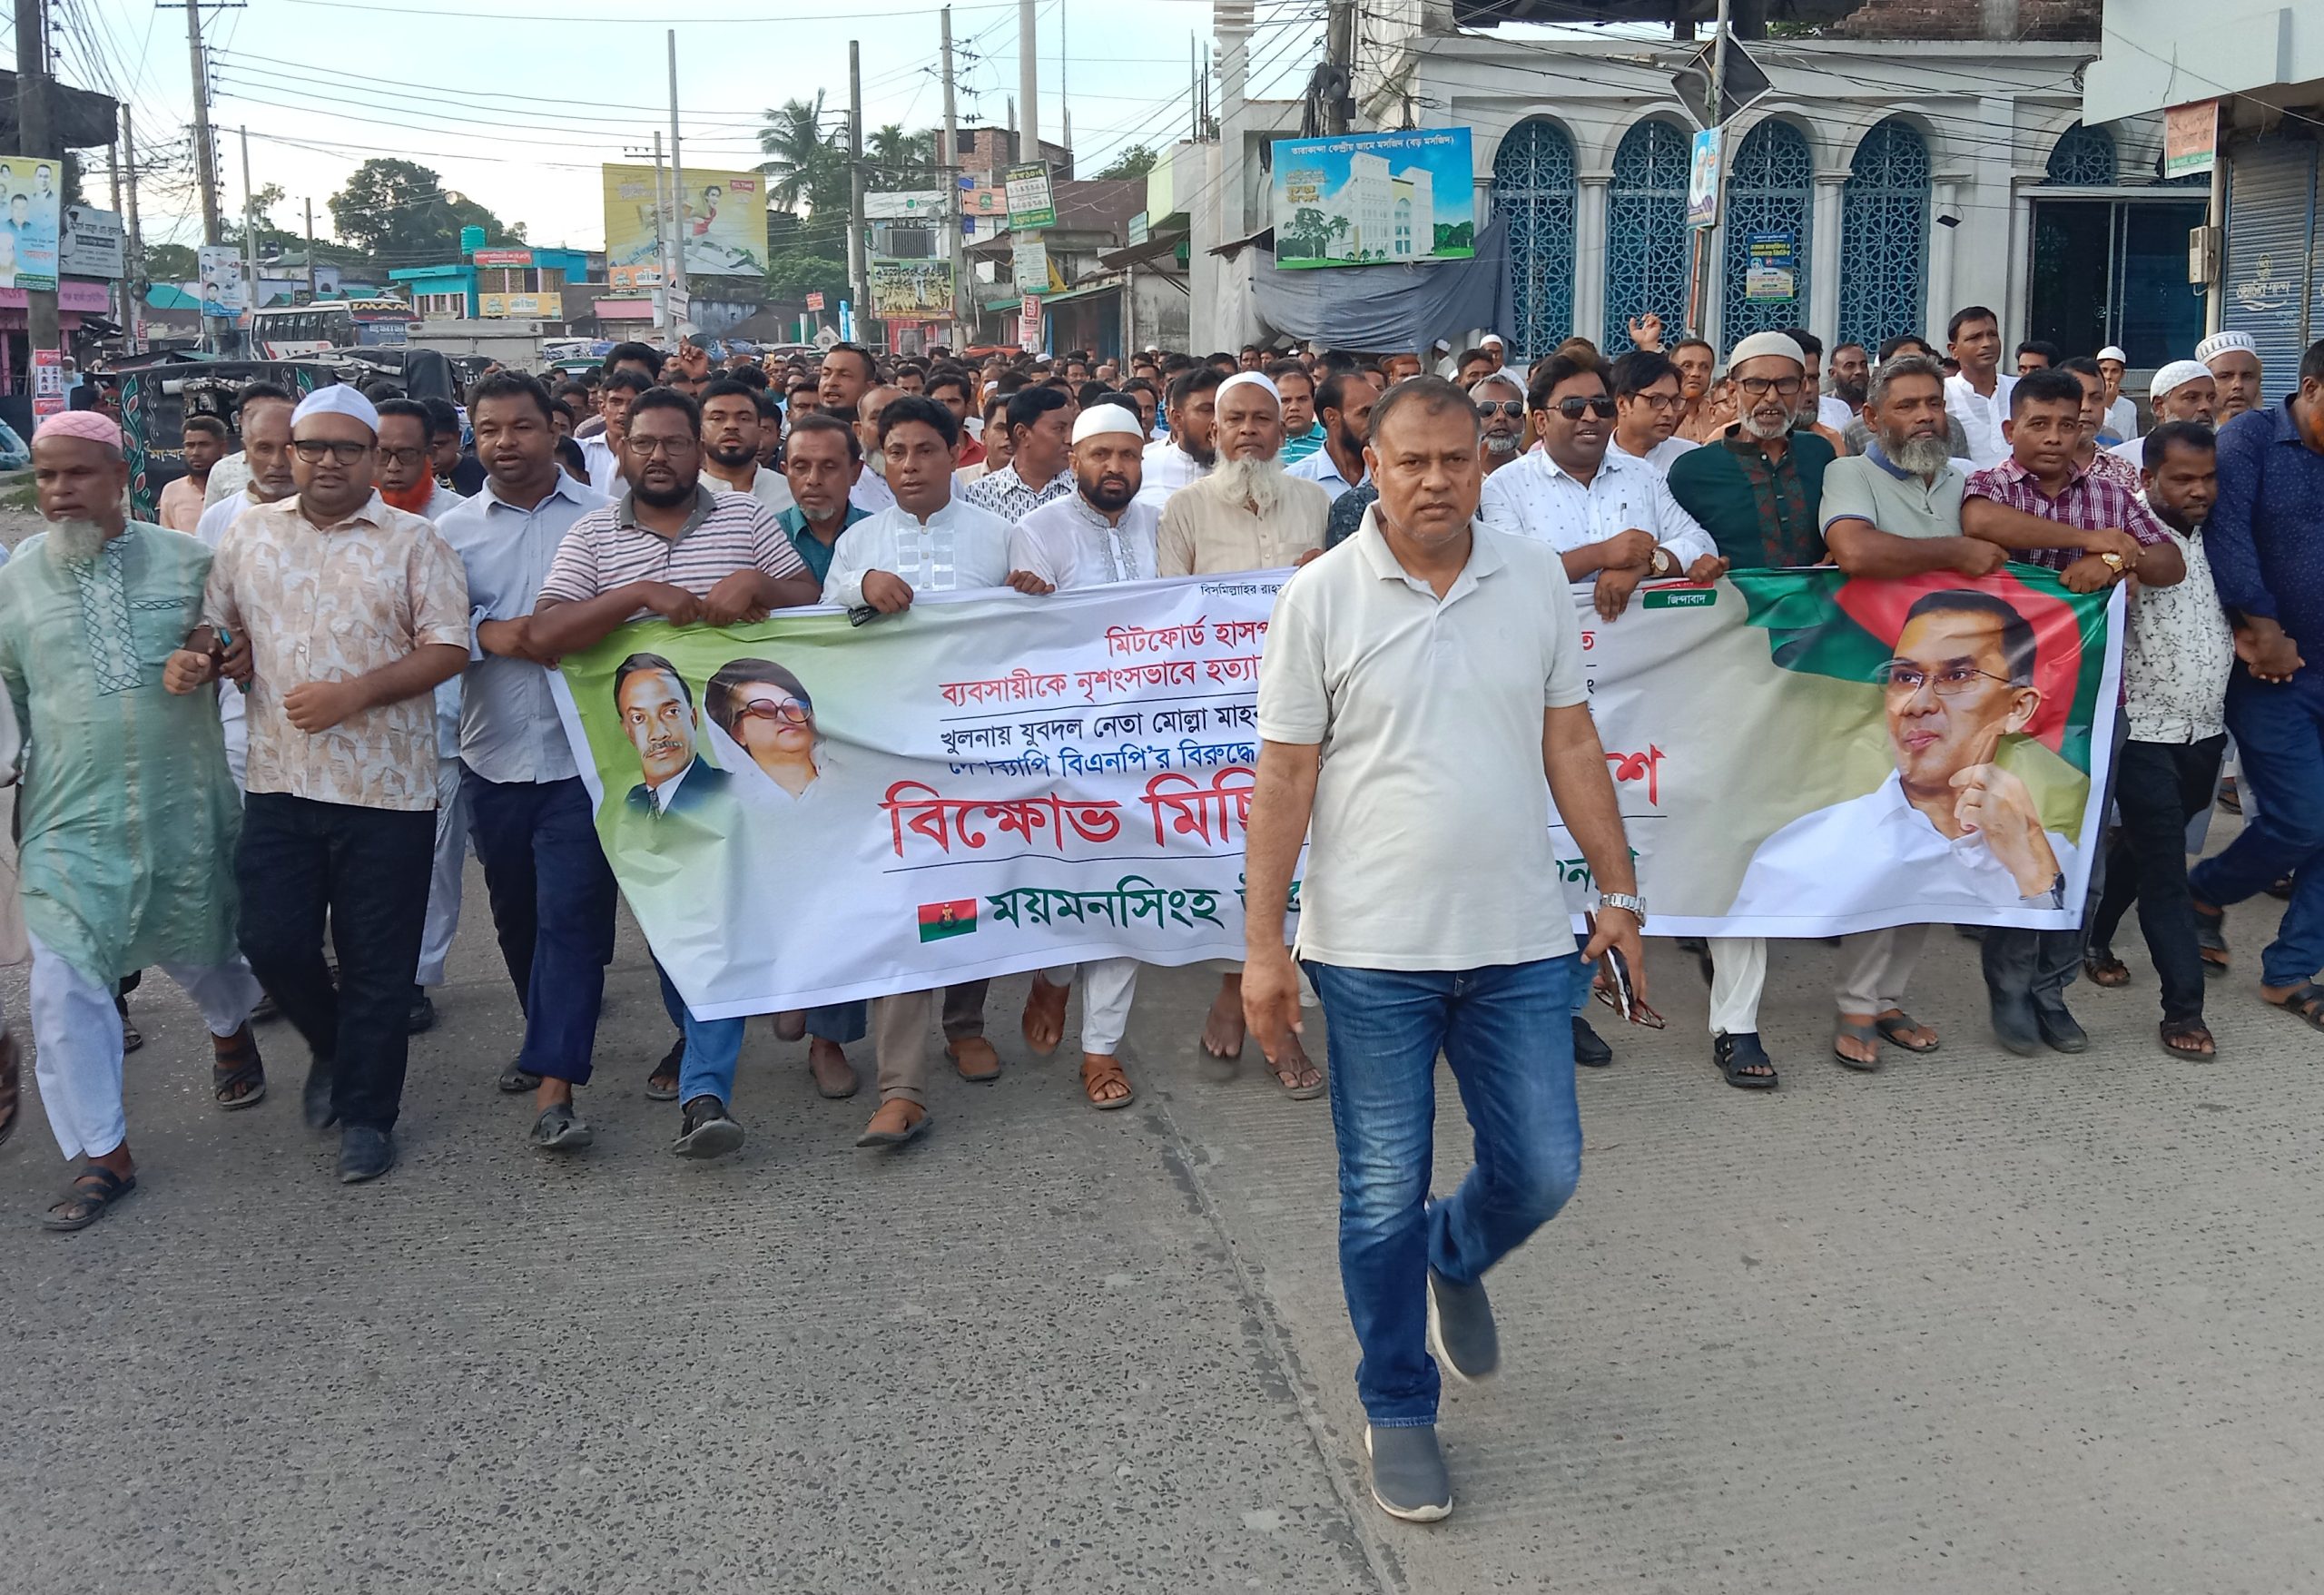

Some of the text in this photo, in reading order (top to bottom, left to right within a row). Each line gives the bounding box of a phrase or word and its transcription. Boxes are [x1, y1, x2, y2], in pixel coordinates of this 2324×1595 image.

[1329, 141, 1354, 153] কেন্দ্রীয়
[1356, 142, 1375, 152] জামে
[1377, 137, 1403, 149] মসজিদ
[352, 301, 413, 312] IMAM
[1667, 594, 1707, 606] জিন্দাবাদ
[1104, 615, 1207, 657] মিটফোর্ড
[939, 655, 1263, 707] ব্যবসায়ীকে নৃশংসভাবে হত্যা
[940, 704, 1258, 756] খুলনায় যুবদল নেতা মোল্লা মাহ
[1057, 743, 1171, 778] বিএনপি’র
[1177, 738, 1256, 768] বিরুদ্ধে
[878, 780, 1122, 859] বিক্ষোভ
[985, 874, 1226, 930] ময়মনসিংহ
